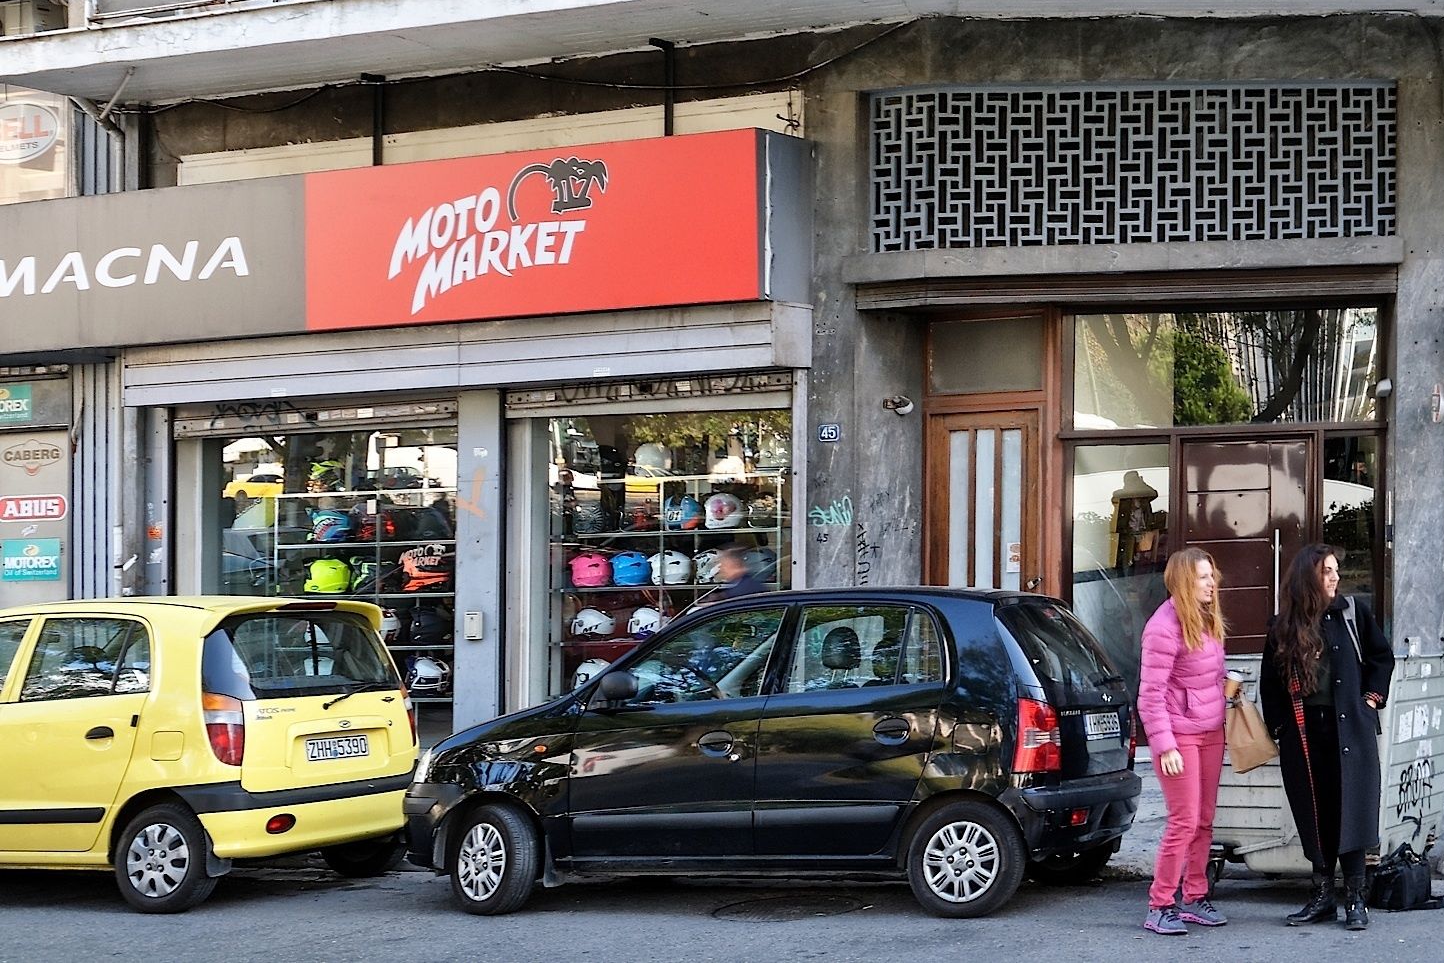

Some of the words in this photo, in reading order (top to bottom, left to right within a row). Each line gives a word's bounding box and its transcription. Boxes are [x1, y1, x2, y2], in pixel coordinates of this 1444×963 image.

[388, 186, 500, 280] MOTO
[0, 236, 249, 297] MACNA
[410, 219, 586, 316] MARKET
[820, 428, 837, 439] 45
[3, 448, 60, 462] CABERG
[3, 499, 60, 517] ABUS
[4, 556, 58, 568] MOTOREX
[336, 737, 368, 756] 5390
